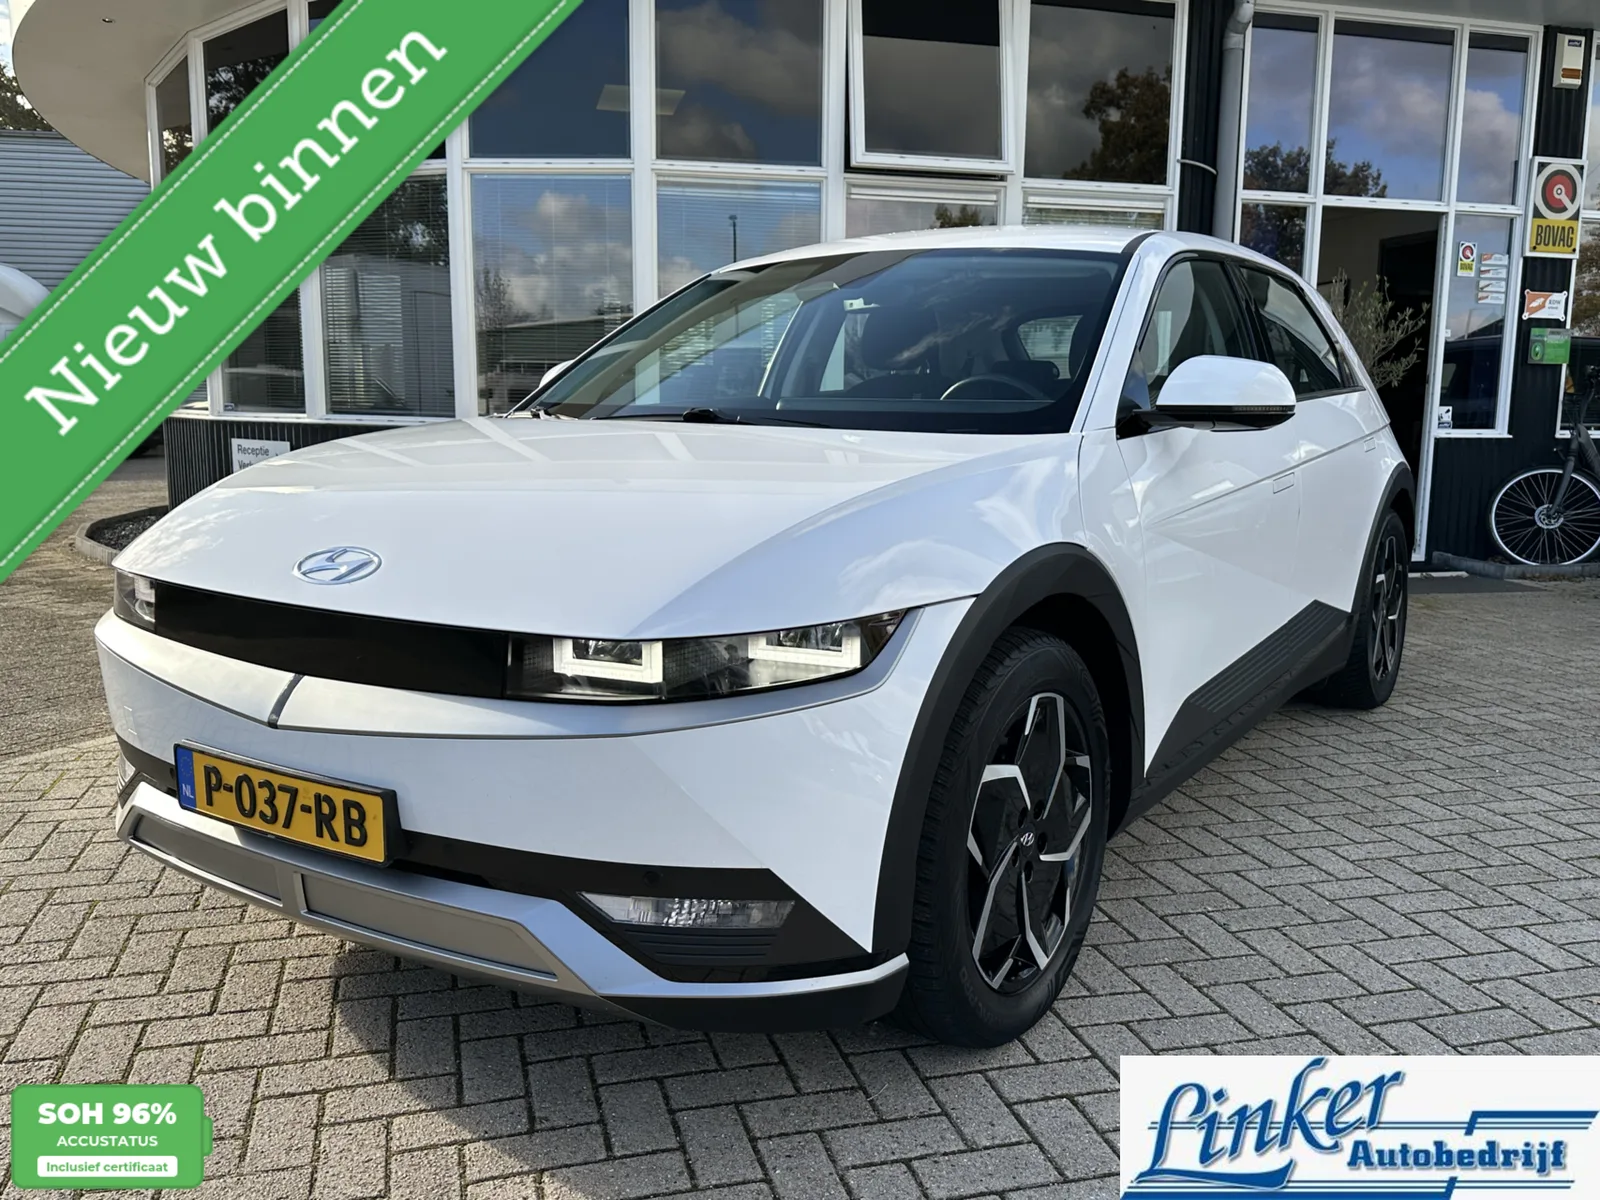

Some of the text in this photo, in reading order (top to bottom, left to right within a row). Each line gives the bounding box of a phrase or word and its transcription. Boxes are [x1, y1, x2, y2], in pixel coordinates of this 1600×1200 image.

[1534, 224, 1575, 248] BOVAG
[237, 444, 270, 457] Receptie
[182, 783, 194, 799] NL
[203, 763, 368, 848] P-037-RB
